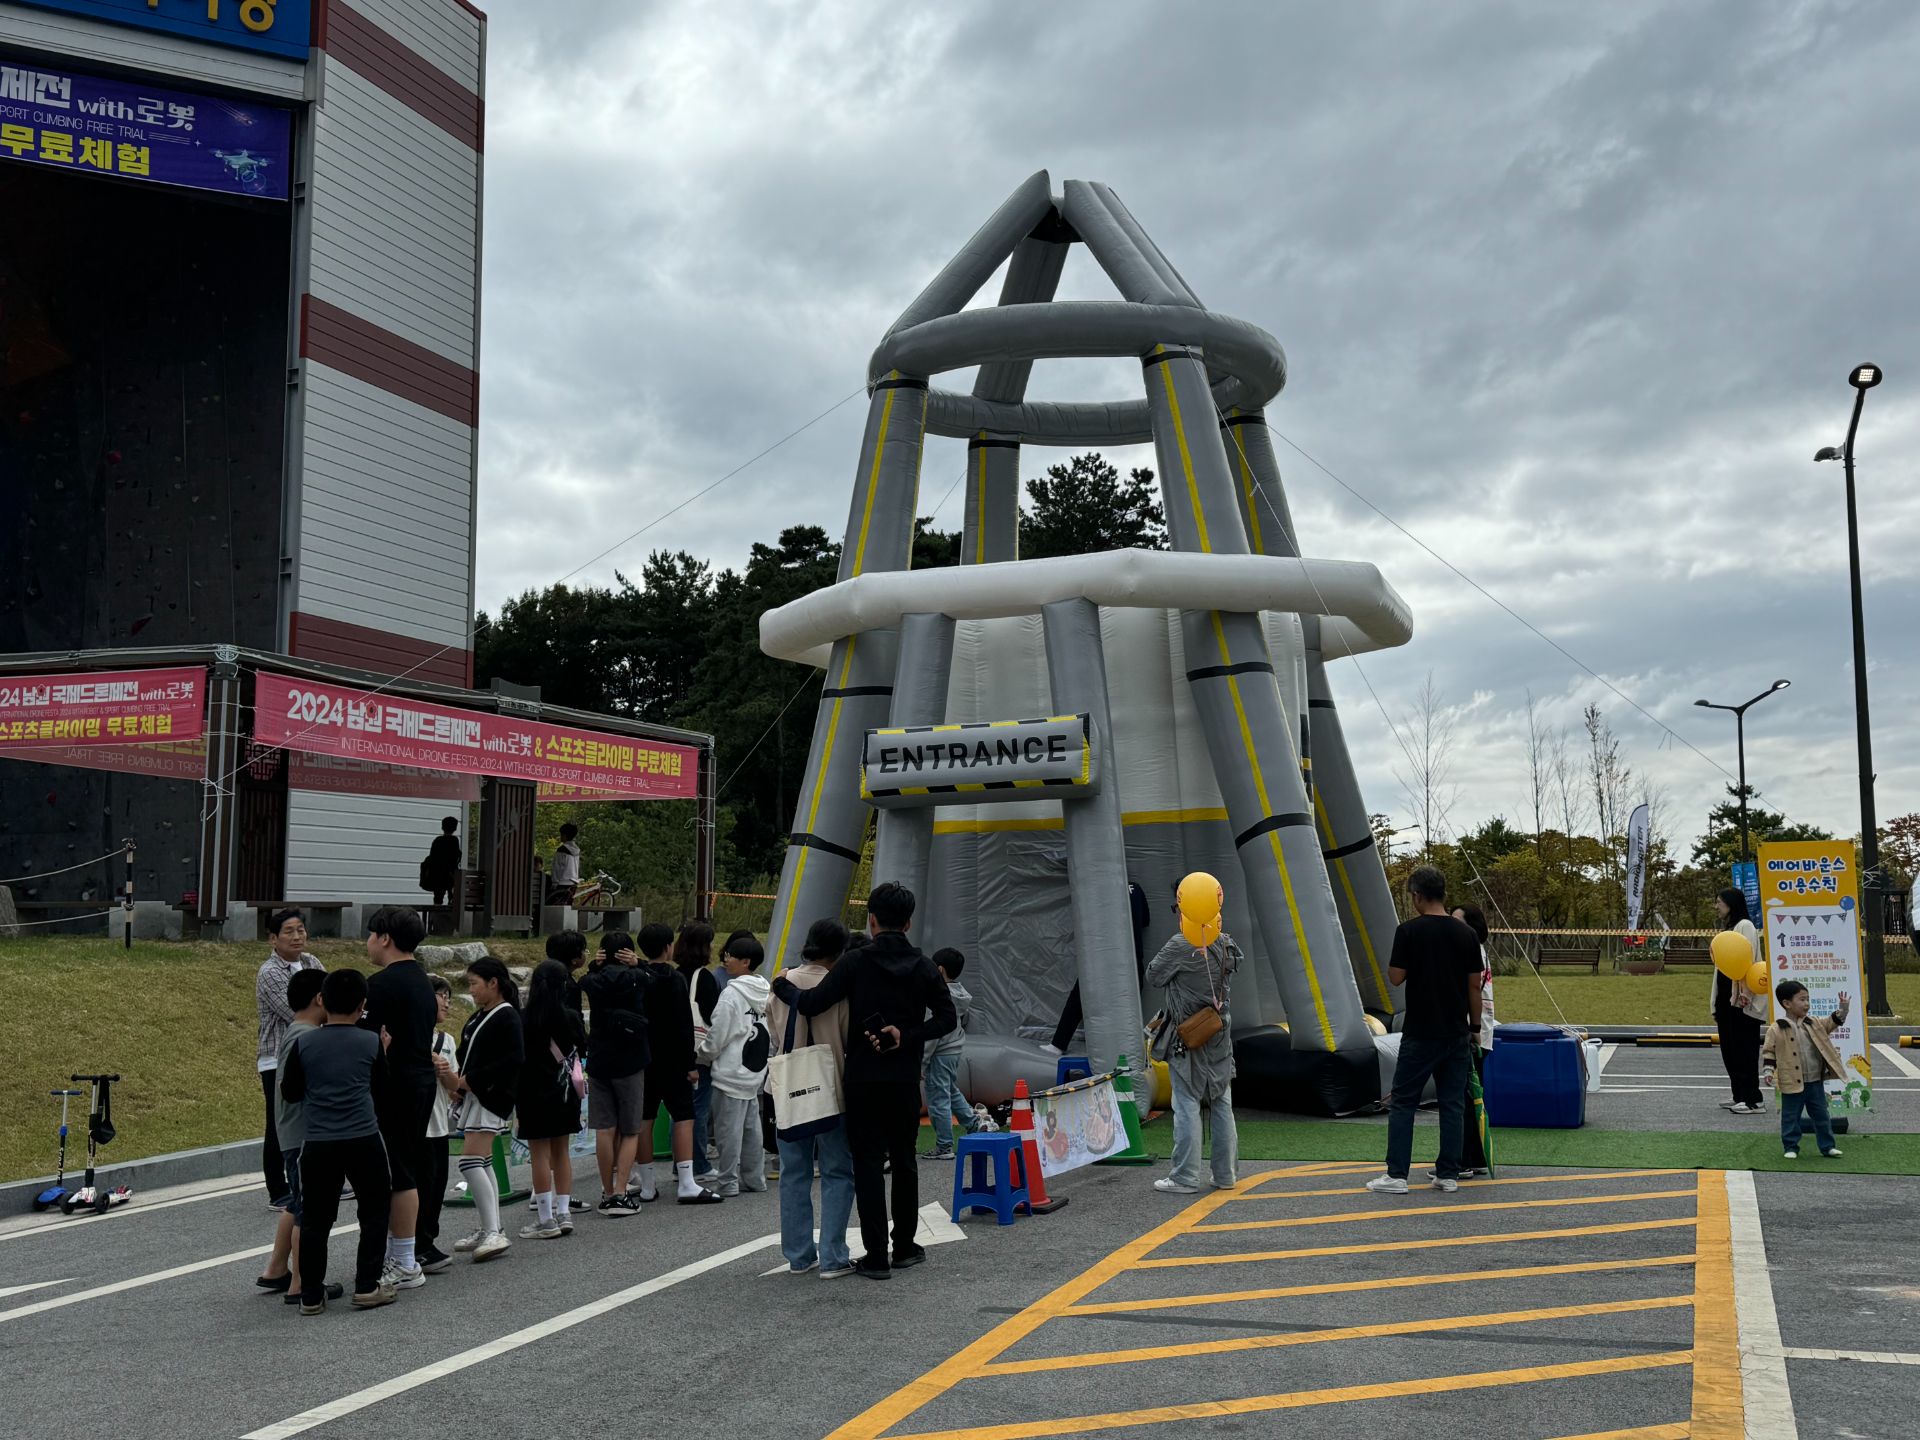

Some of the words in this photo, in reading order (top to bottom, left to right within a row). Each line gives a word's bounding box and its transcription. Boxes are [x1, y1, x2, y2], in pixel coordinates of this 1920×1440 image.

[34, 110, 82, 130] CLIMBING
[86, 120, 114, 135] FREE
[118, 125, 147, 141] TRIAL
[0, 123, 150, 176] 무료체험
[52, 681, 138, 704] 국제드론제전
[0, 718, 100, 740] 스포츠클라이밍
[107, 714, 172, 737] 무료체험
[287, 688, 344, 727] 2024
[347, 698, 382, 734] 남원
[386, 706, 480, 748] 국제드론제전
[534, 737, 542, 757] &
[546, 735, 634, 771] 스포츠클라이밍
[636, 748, 682, 778] 무료체험
[341, 737, 416, 760] INTERNATIONAL
[418, 748, 450, 765] DRONE
[452, 752, 478, 768] FESTA
[480, 757, 502, 772] 2024
[504, 760, 524, 774] WITH
[525, 763, 550, 778] ROBOT
[552, 766, 558, 778] &
[558, 768, 582, 782] SPORT
[584, 772, 614, 786] CLIMBING
[615, 774, 632, 788] FREE
[634, 777, 651, 788] TRIAL
[880, 735, 1067, 773] ENTRANCE
[1632, 825, 1644, 898] RADIOMASTER
[1768, 856, 1846, 874] 에어바운스
[1778, 876, 1837, 894] 이용수칙
[1777, 954, 1788, 970] 2
